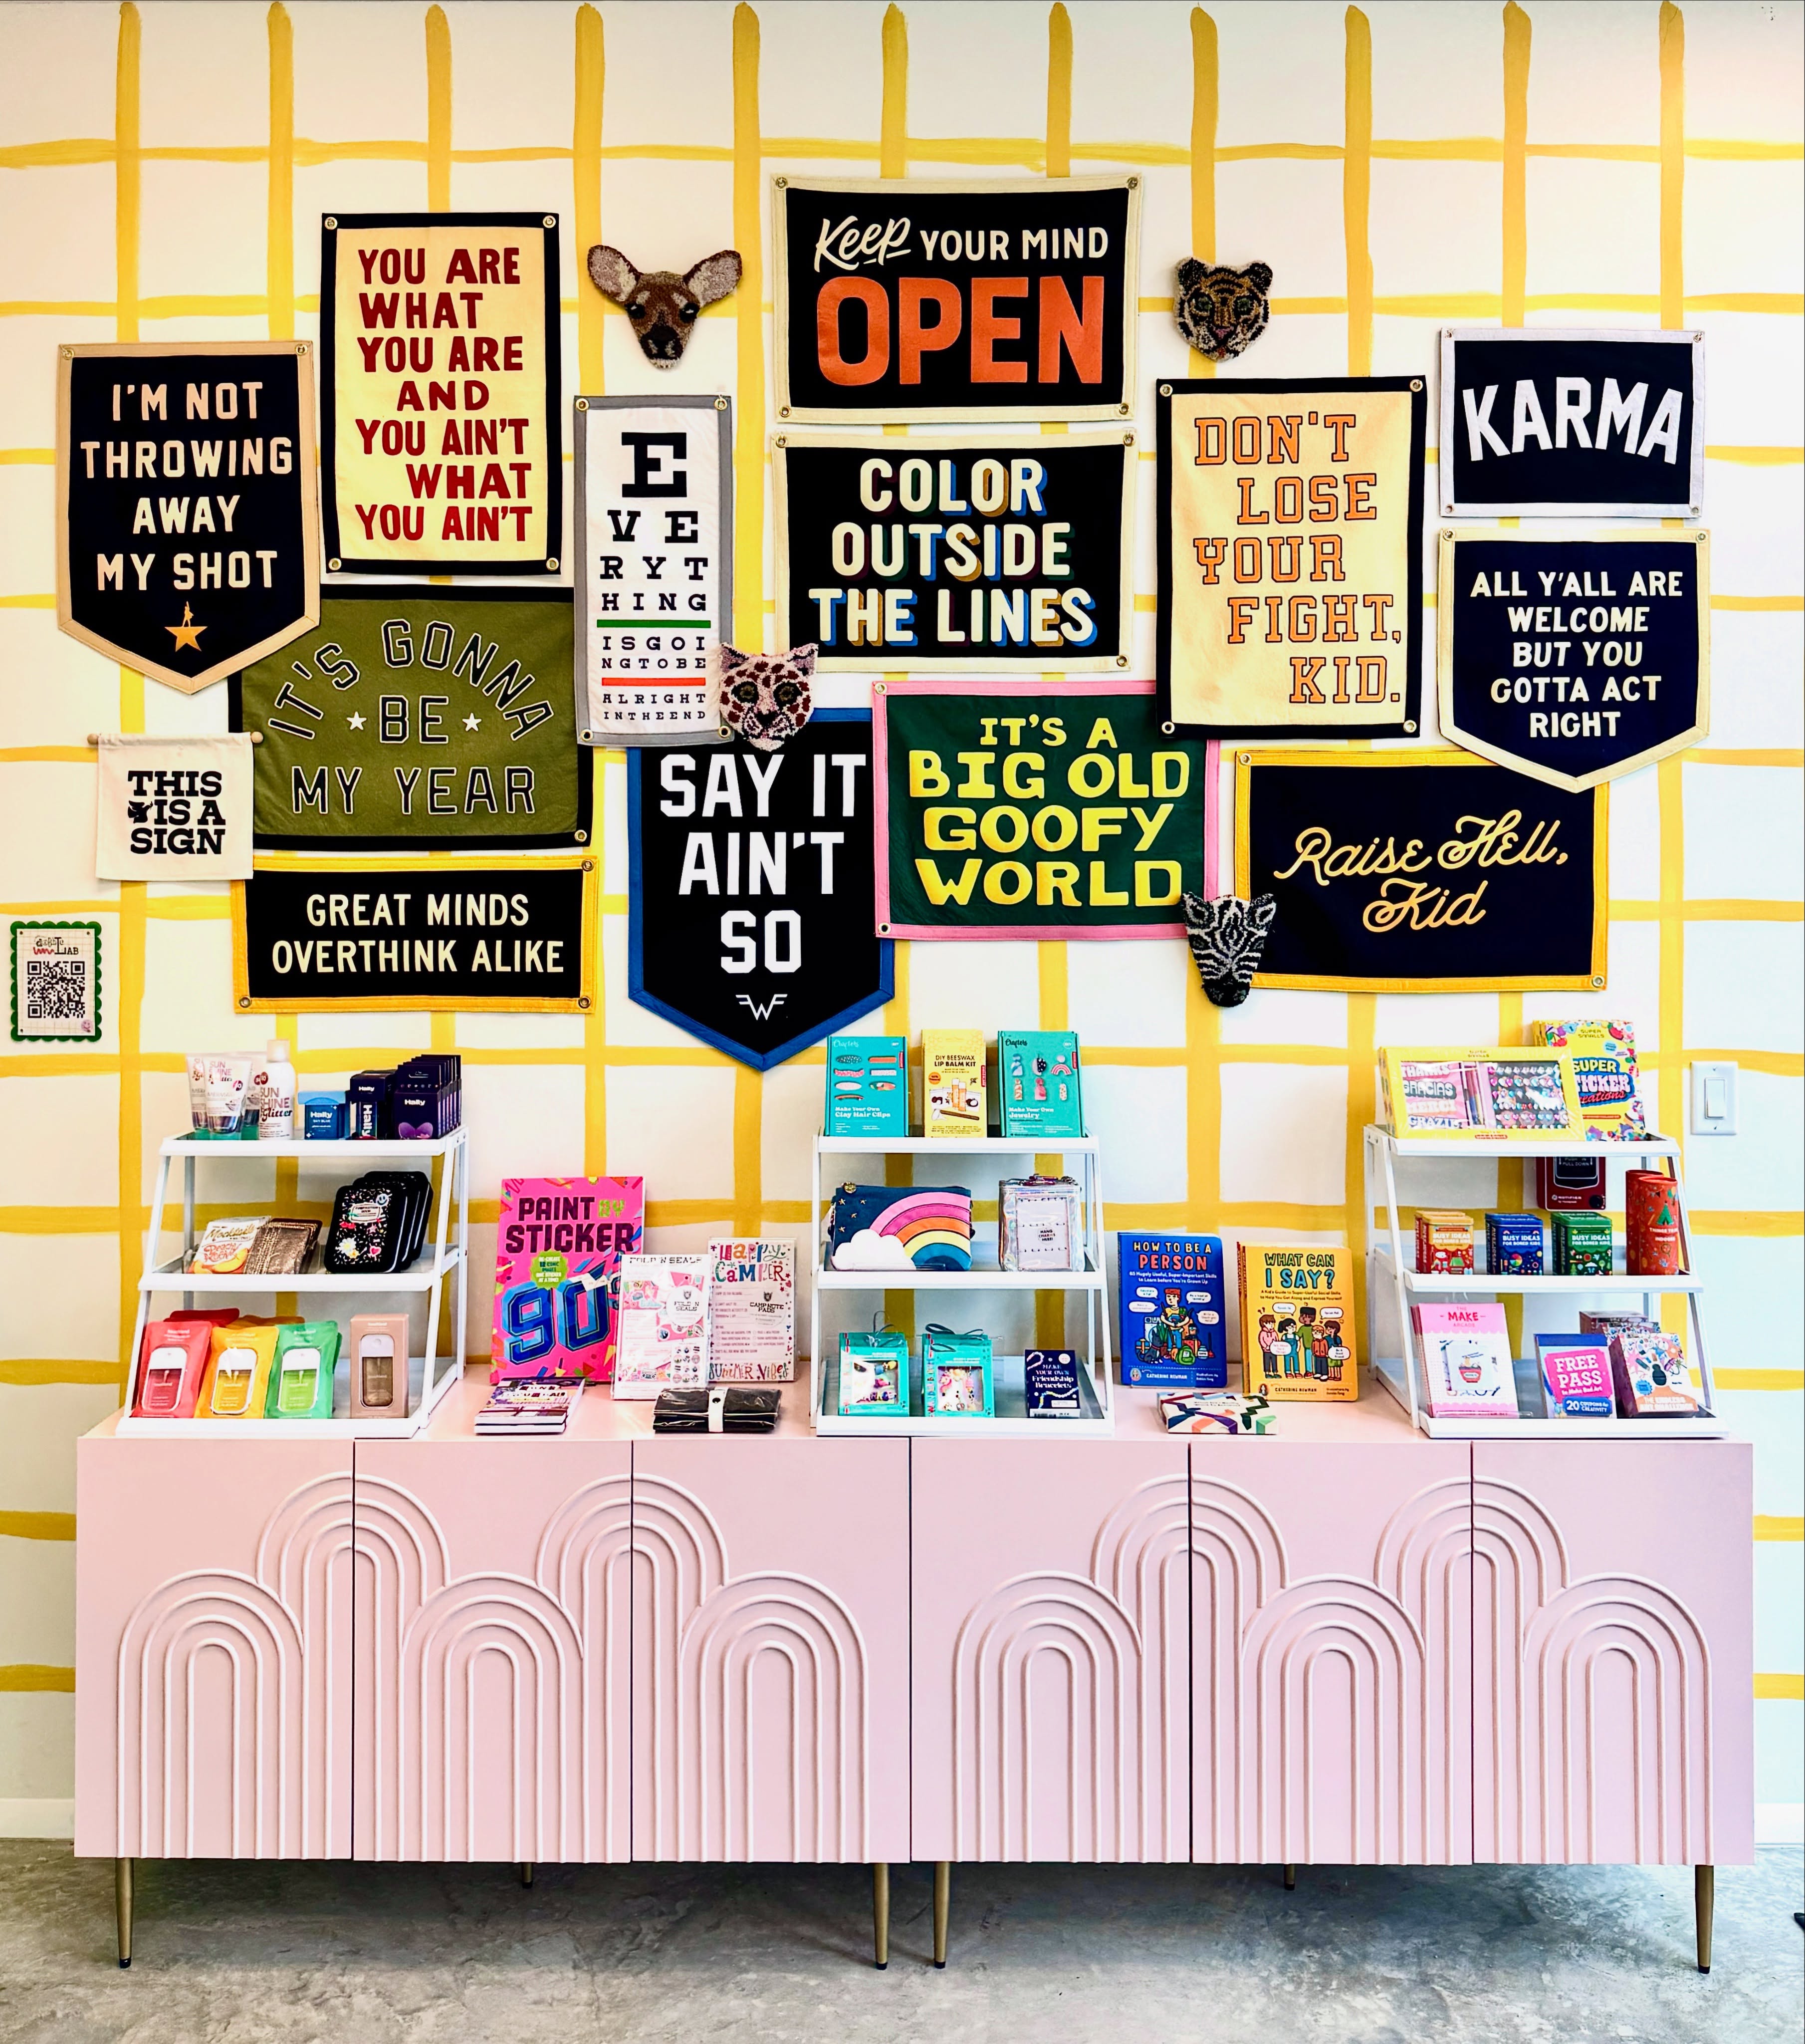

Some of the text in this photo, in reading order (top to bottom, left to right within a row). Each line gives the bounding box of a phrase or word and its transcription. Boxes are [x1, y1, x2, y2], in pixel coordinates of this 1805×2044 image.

[814, 215, 1108, 272] Keep YOUR MIND
[358, 248, 520, 284] YOU ARE
[359, 292, 483, 329] WHAT
[817, 275, 1105, 386] OPEN
[357, 336, 522, 372] YOU ARE
[112, 382, 262, 421] I'M NOT
[397, 380, 489, 411] AND
[355, 418, 528, 456] YOU AIN'T
[1194, 411, 1356, 466] DON'T
[1462, 377, 1683, 465] KARMA
[80, 437, 292, 478] THROWING
[622, 432, 687, 498] E
[406, 463, 531, 499] WHAT
[860, 458, 1047, 517] COLOR
[1237, 473, 1377, 525] LOSE
[133, 496, 240, 533] AWAY
[355, 504, 532, 541] YOU AIN'T
[97, 550, 277, 590] MY SHOT
[832, 522, 1075, 582] OUTSIDE
[1193, 534, 1346, 585] YOUR
[1470, 571, 1683, 597] ALL Y'ALL ARE
[809, 587, 1098, 647] THE LINES
[1227, 594, 1401, 644] FIGHT,
[1507, 606, 1649, 633] WELCOME
[1513, 641, 1642, 667] BUT YOU
[268, 618, 554, 741] IT'S GONNA
[1289, 656, 1401, 703] KID.
[1490, 676, 1661, 703] GOTTA ACT
[603, 693, 706, 704] ALRIGHT
[379, 695, 449, 743] BE
[980, 714, 1118, 749] IT'S A
[1530, 711, 1621, 738] RIGHT
[128, 770, 222, 797] THIS
[291, 766, 535, 814] MY YEAR
[660, 754, 866, 817] SAY IT
[909, 750, 1190, 799] BIG OLD
[154, 799, 226, 825] IS A
[923, 803, 1174, 853] GOOFY
[131, 828, 226, 854] SIGN
[1273, 809, 1569, 886] Raise Hell,
[678, 832, 844, 895] AIN'T
[914, 858, 1182, 907] WORLD
[306, 894, 529, 927] GREAT MINDS
[1362, 878, 1489, 933] Kid
[272, 940, 564, 974] OVERTHINK ALIKE
[720, 910, 801, 973] SO
[1005, 1039, 1027, 1048] Crafters
[1573, 1059, 1616, 1072] SUPER
[1576, 1074, 1630, 1092] TICKER
[1403, 1080, 1456, 1098] GRACIAS
[518, 1197, 624, 1221] PAINT BY
[506, 1223, 634, 1253] STICKER
[1133, 1242, 1211, 1253] HOW TO BE A
[1139, 1255, 1207, 1270] PERSON
[1265, 1253, 1334, 1267] WHAT CAN
[1266, 1268, 1335, 1289] I SAY?
[1448, 1312, 1479, 1321] MAKE
[1554, 1354, 1598, 1372] FREE
[1558, 1370, 1602, 1388] PASS
[1566, 1400, 1579, 1410] 20
